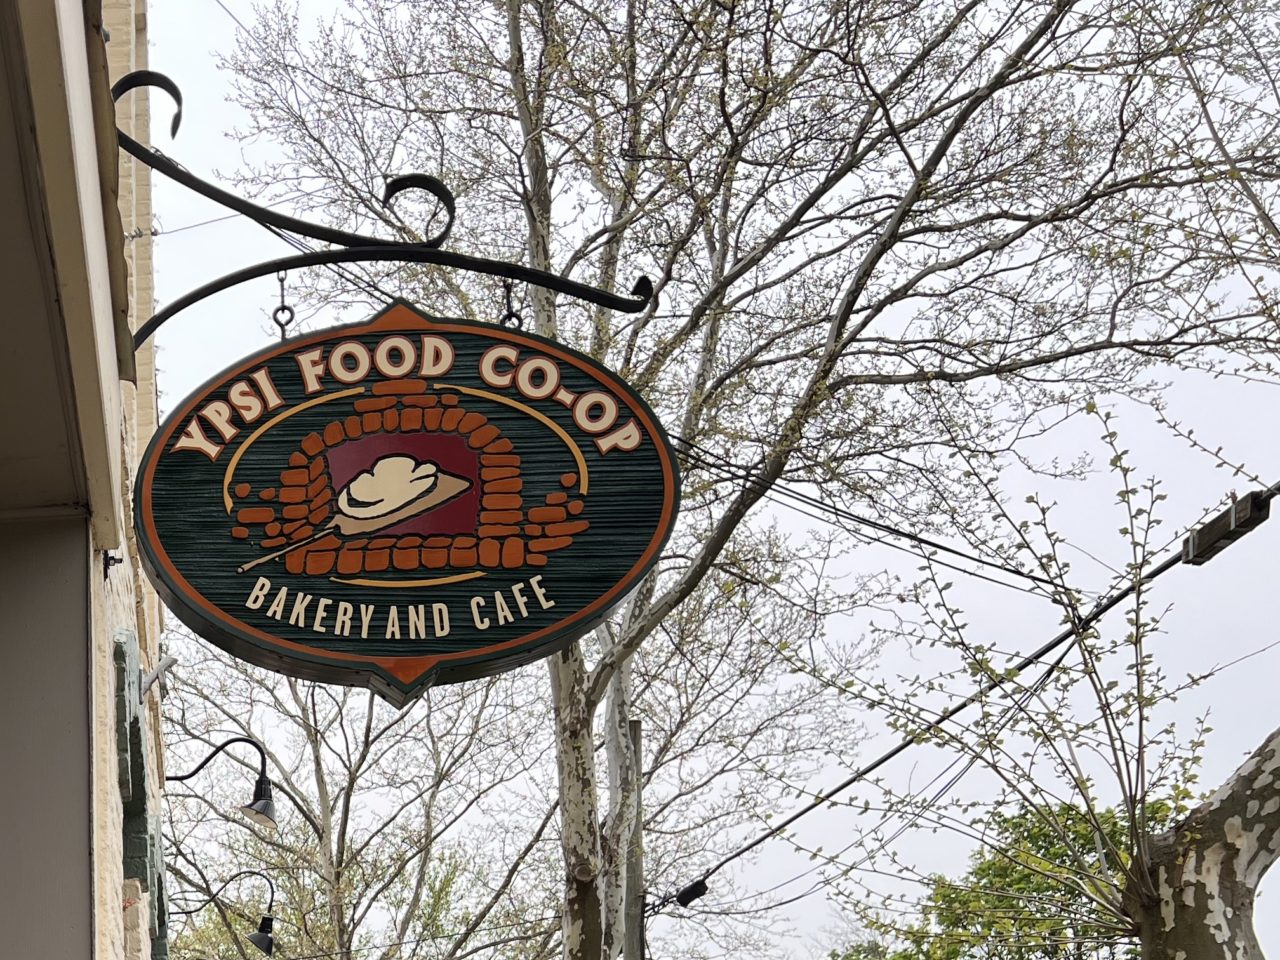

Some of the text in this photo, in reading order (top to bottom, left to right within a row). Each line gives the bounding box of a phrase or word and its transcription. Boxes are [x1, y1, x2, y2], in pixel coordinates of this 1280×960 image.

[170, 334, 642, 462] YPSI FOOD CO-OP
[245, 574, 556, 640] BAKERY AND CAFE
